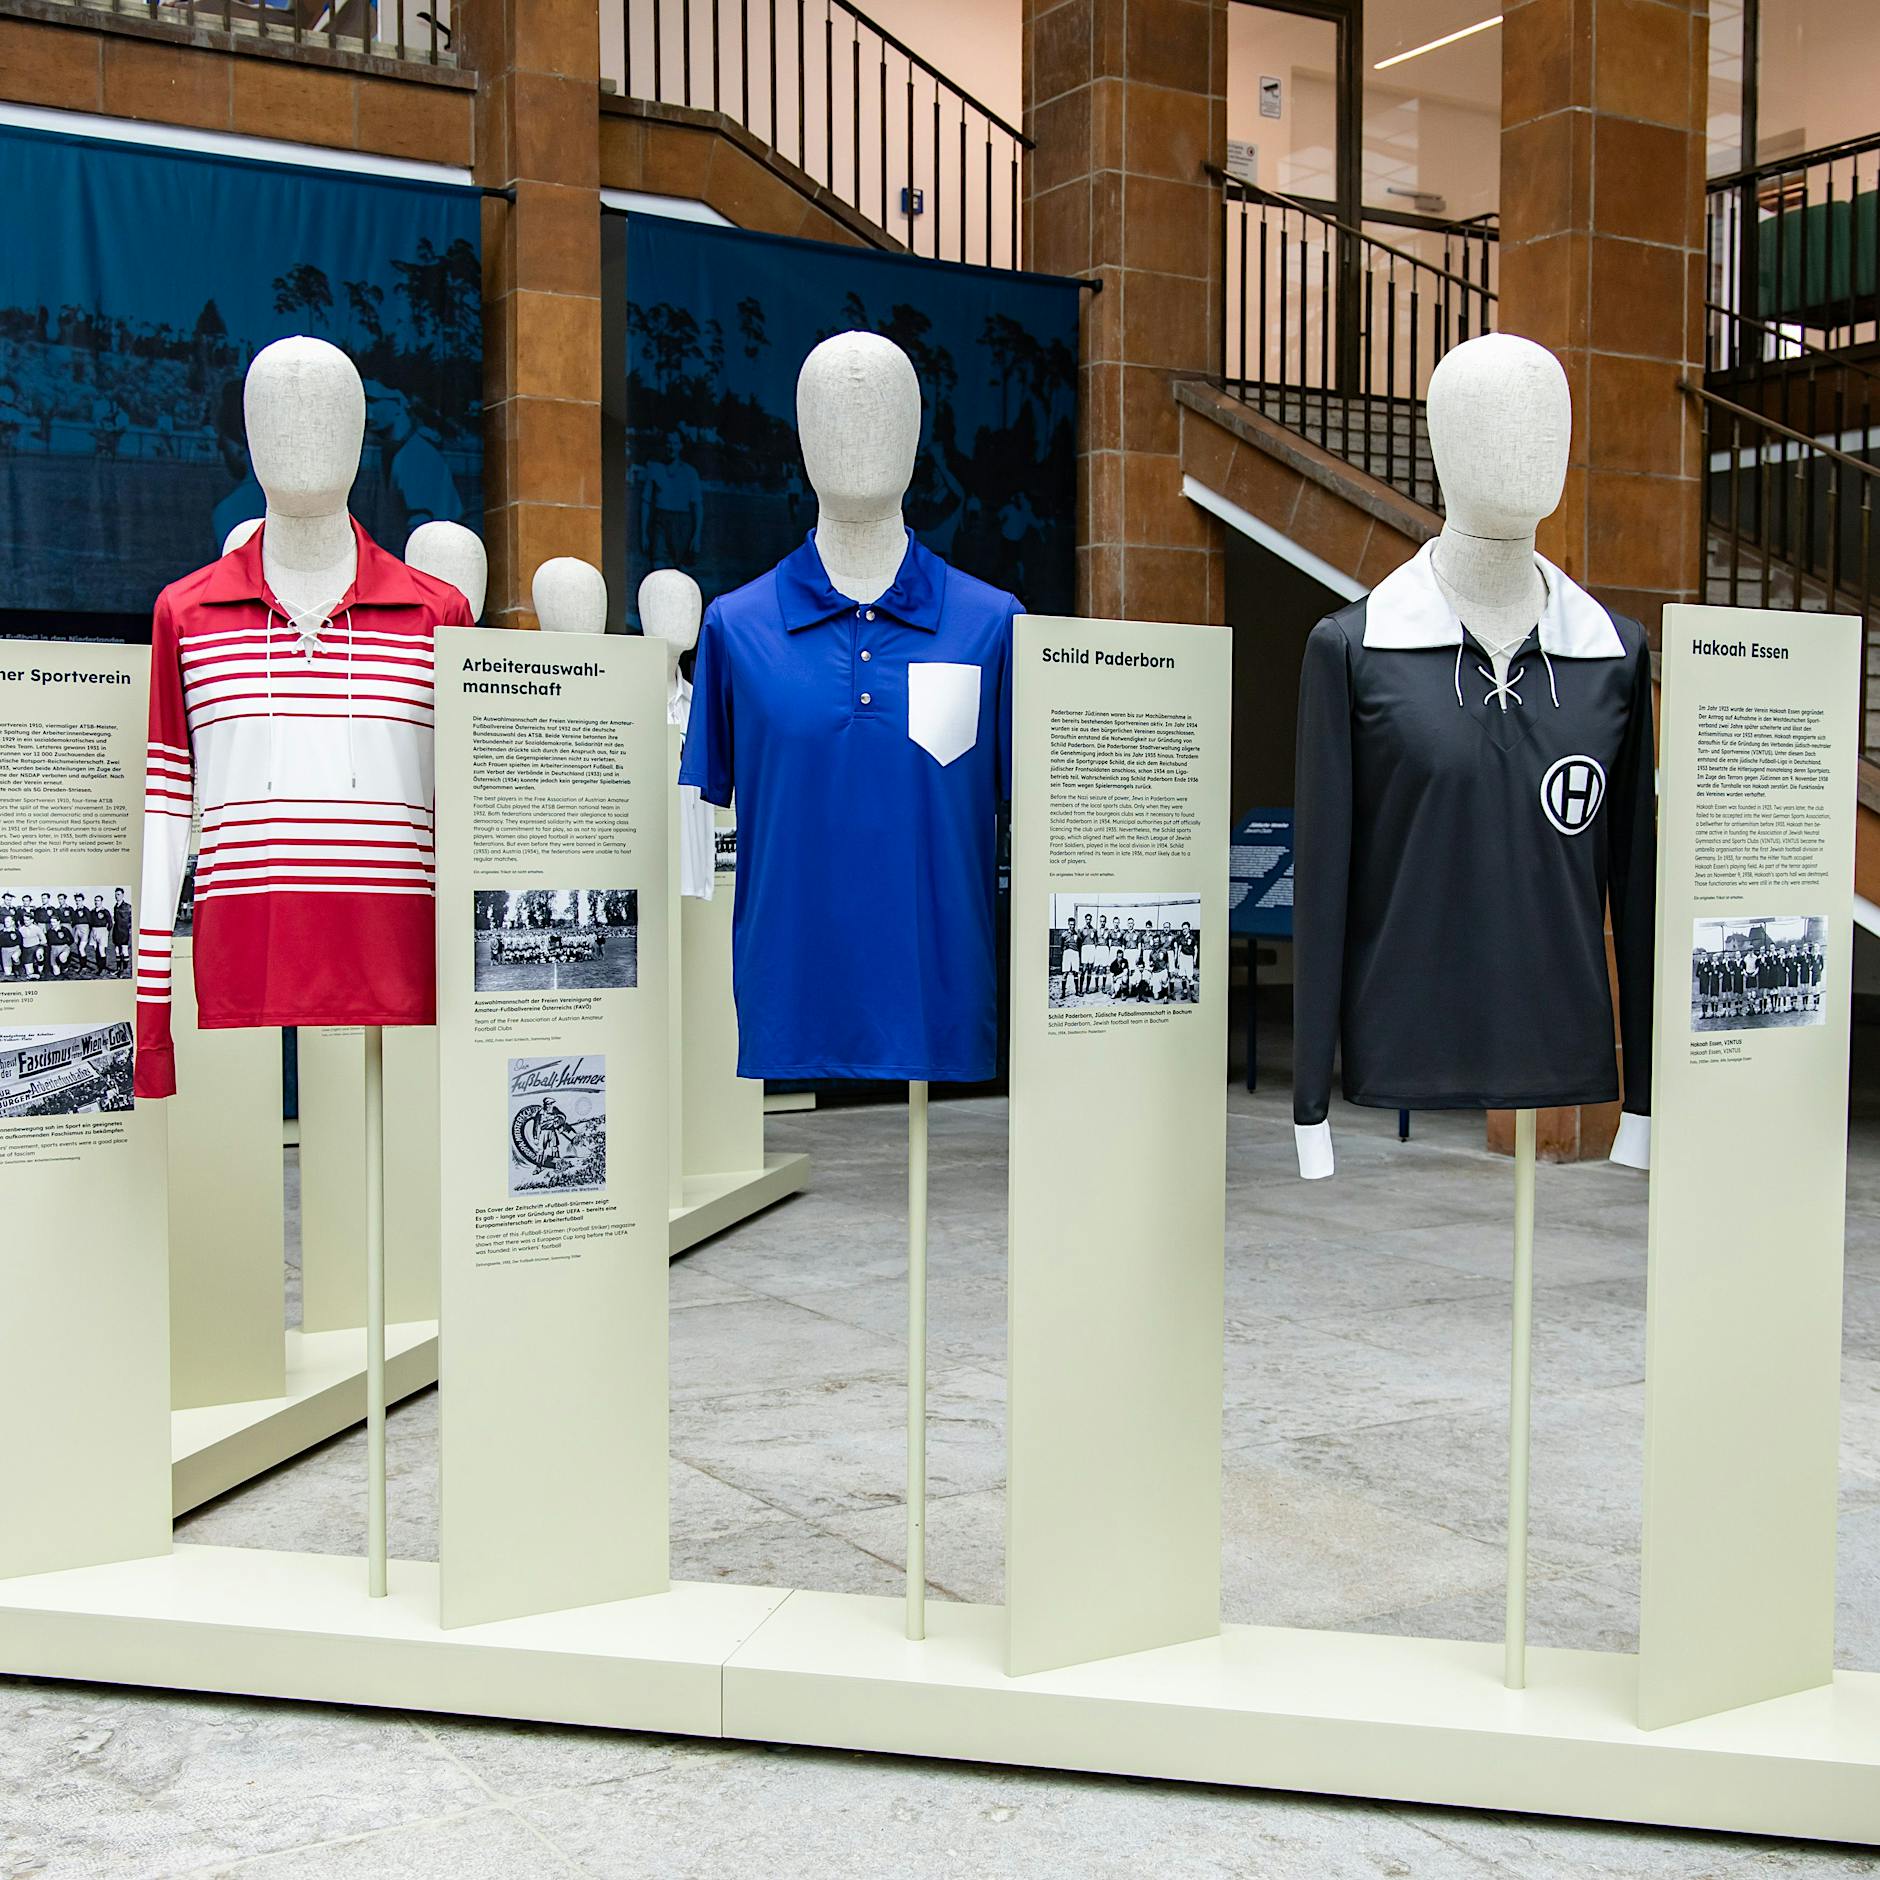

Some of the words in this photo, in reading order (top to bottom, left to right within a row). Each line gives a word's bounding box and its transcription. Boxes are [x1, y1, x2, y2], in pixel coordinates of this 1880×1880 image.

[1042, 648, 1090, 664] Schild
[1096, 650, 1175, 668] Paderborn
[1693, 640, 1746, 656] Hakoah
[1752, 643, 1789, 660] Essen
[462, 658, 606, 676] Arbeiterauswahl-
[30, 668, 130, 686] Sportverein
[464, 681, 562, 696] mannschaft
[18, 1048, 72, 1073] Fascismus
[82, 1036, 102, 1056] Wien
